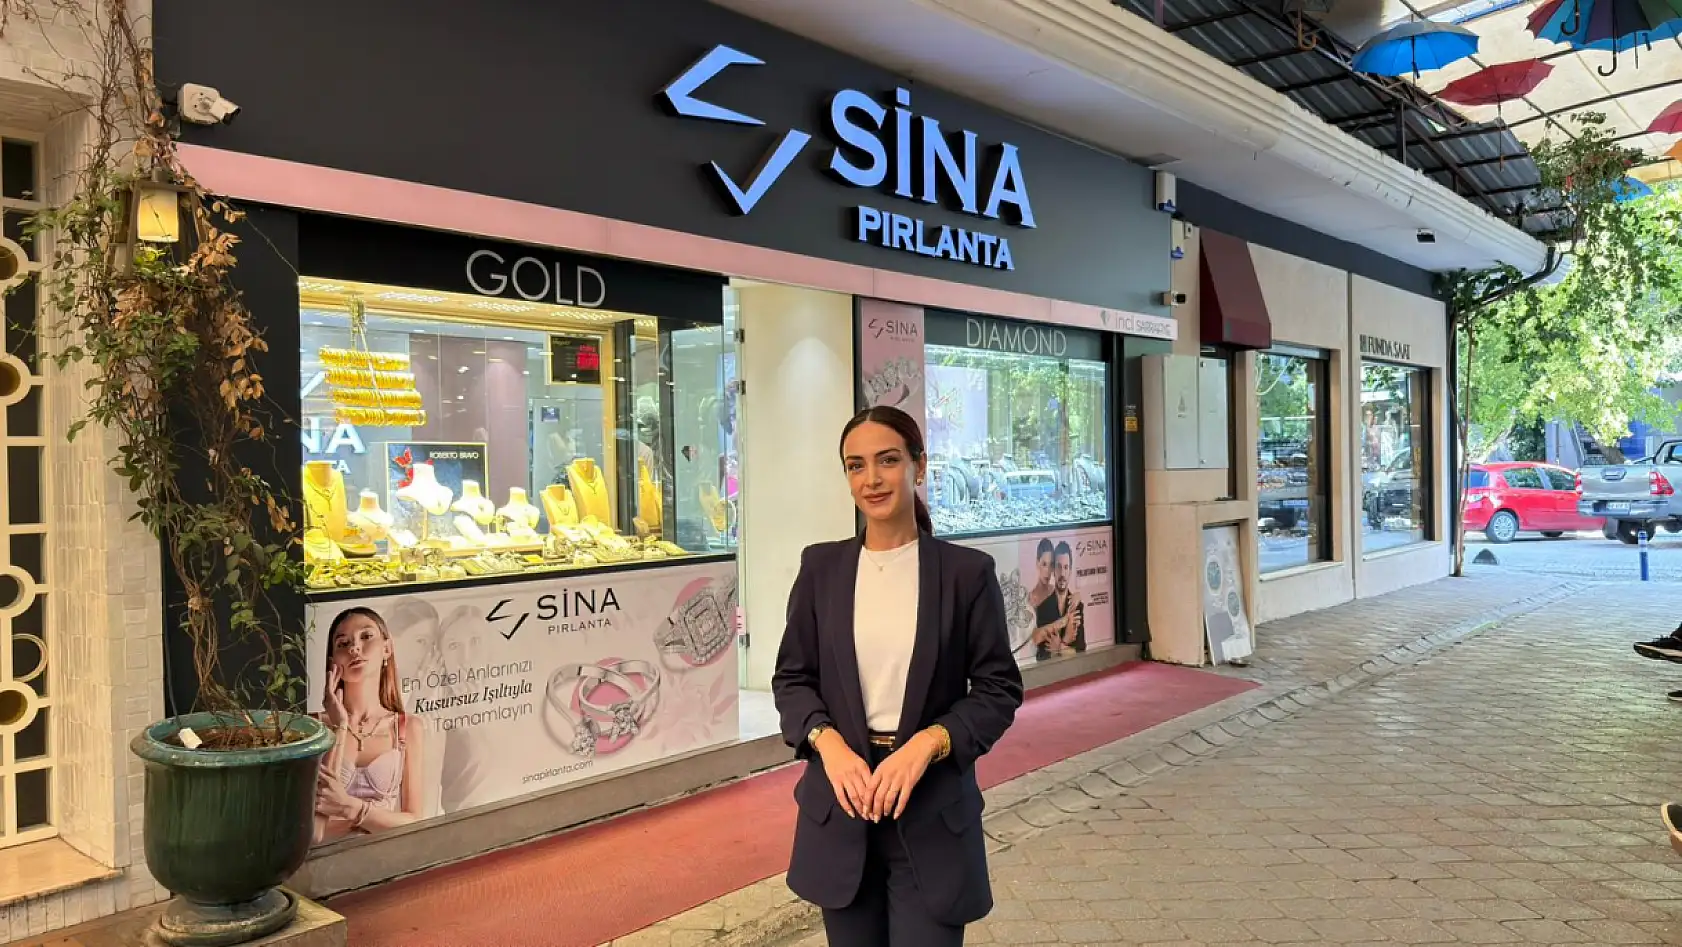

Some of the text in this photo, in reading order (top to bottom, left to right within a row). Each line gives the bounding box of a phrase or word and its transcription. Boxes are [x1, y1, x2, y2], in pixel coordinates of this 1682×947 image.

[830, 87, 1037, 229] SİNA
[858, 205, 1016, 271] PIRLANTA
[466, 249, 606, 308] GOLD
[965, 318, 1067, 357] DIAMOND
[536, 587, 621, 621] SİNA
[548, 617, 612, 635] PIRLANTA
[401, 660, 532, 694] En Özel Anlarınızı
[415, 679, 532, 715] Kusursuz Işıltıyla
[434, 701, 533, 733] Tamamlayın
[522, 759, 594, 784] sinapirlanta.com
